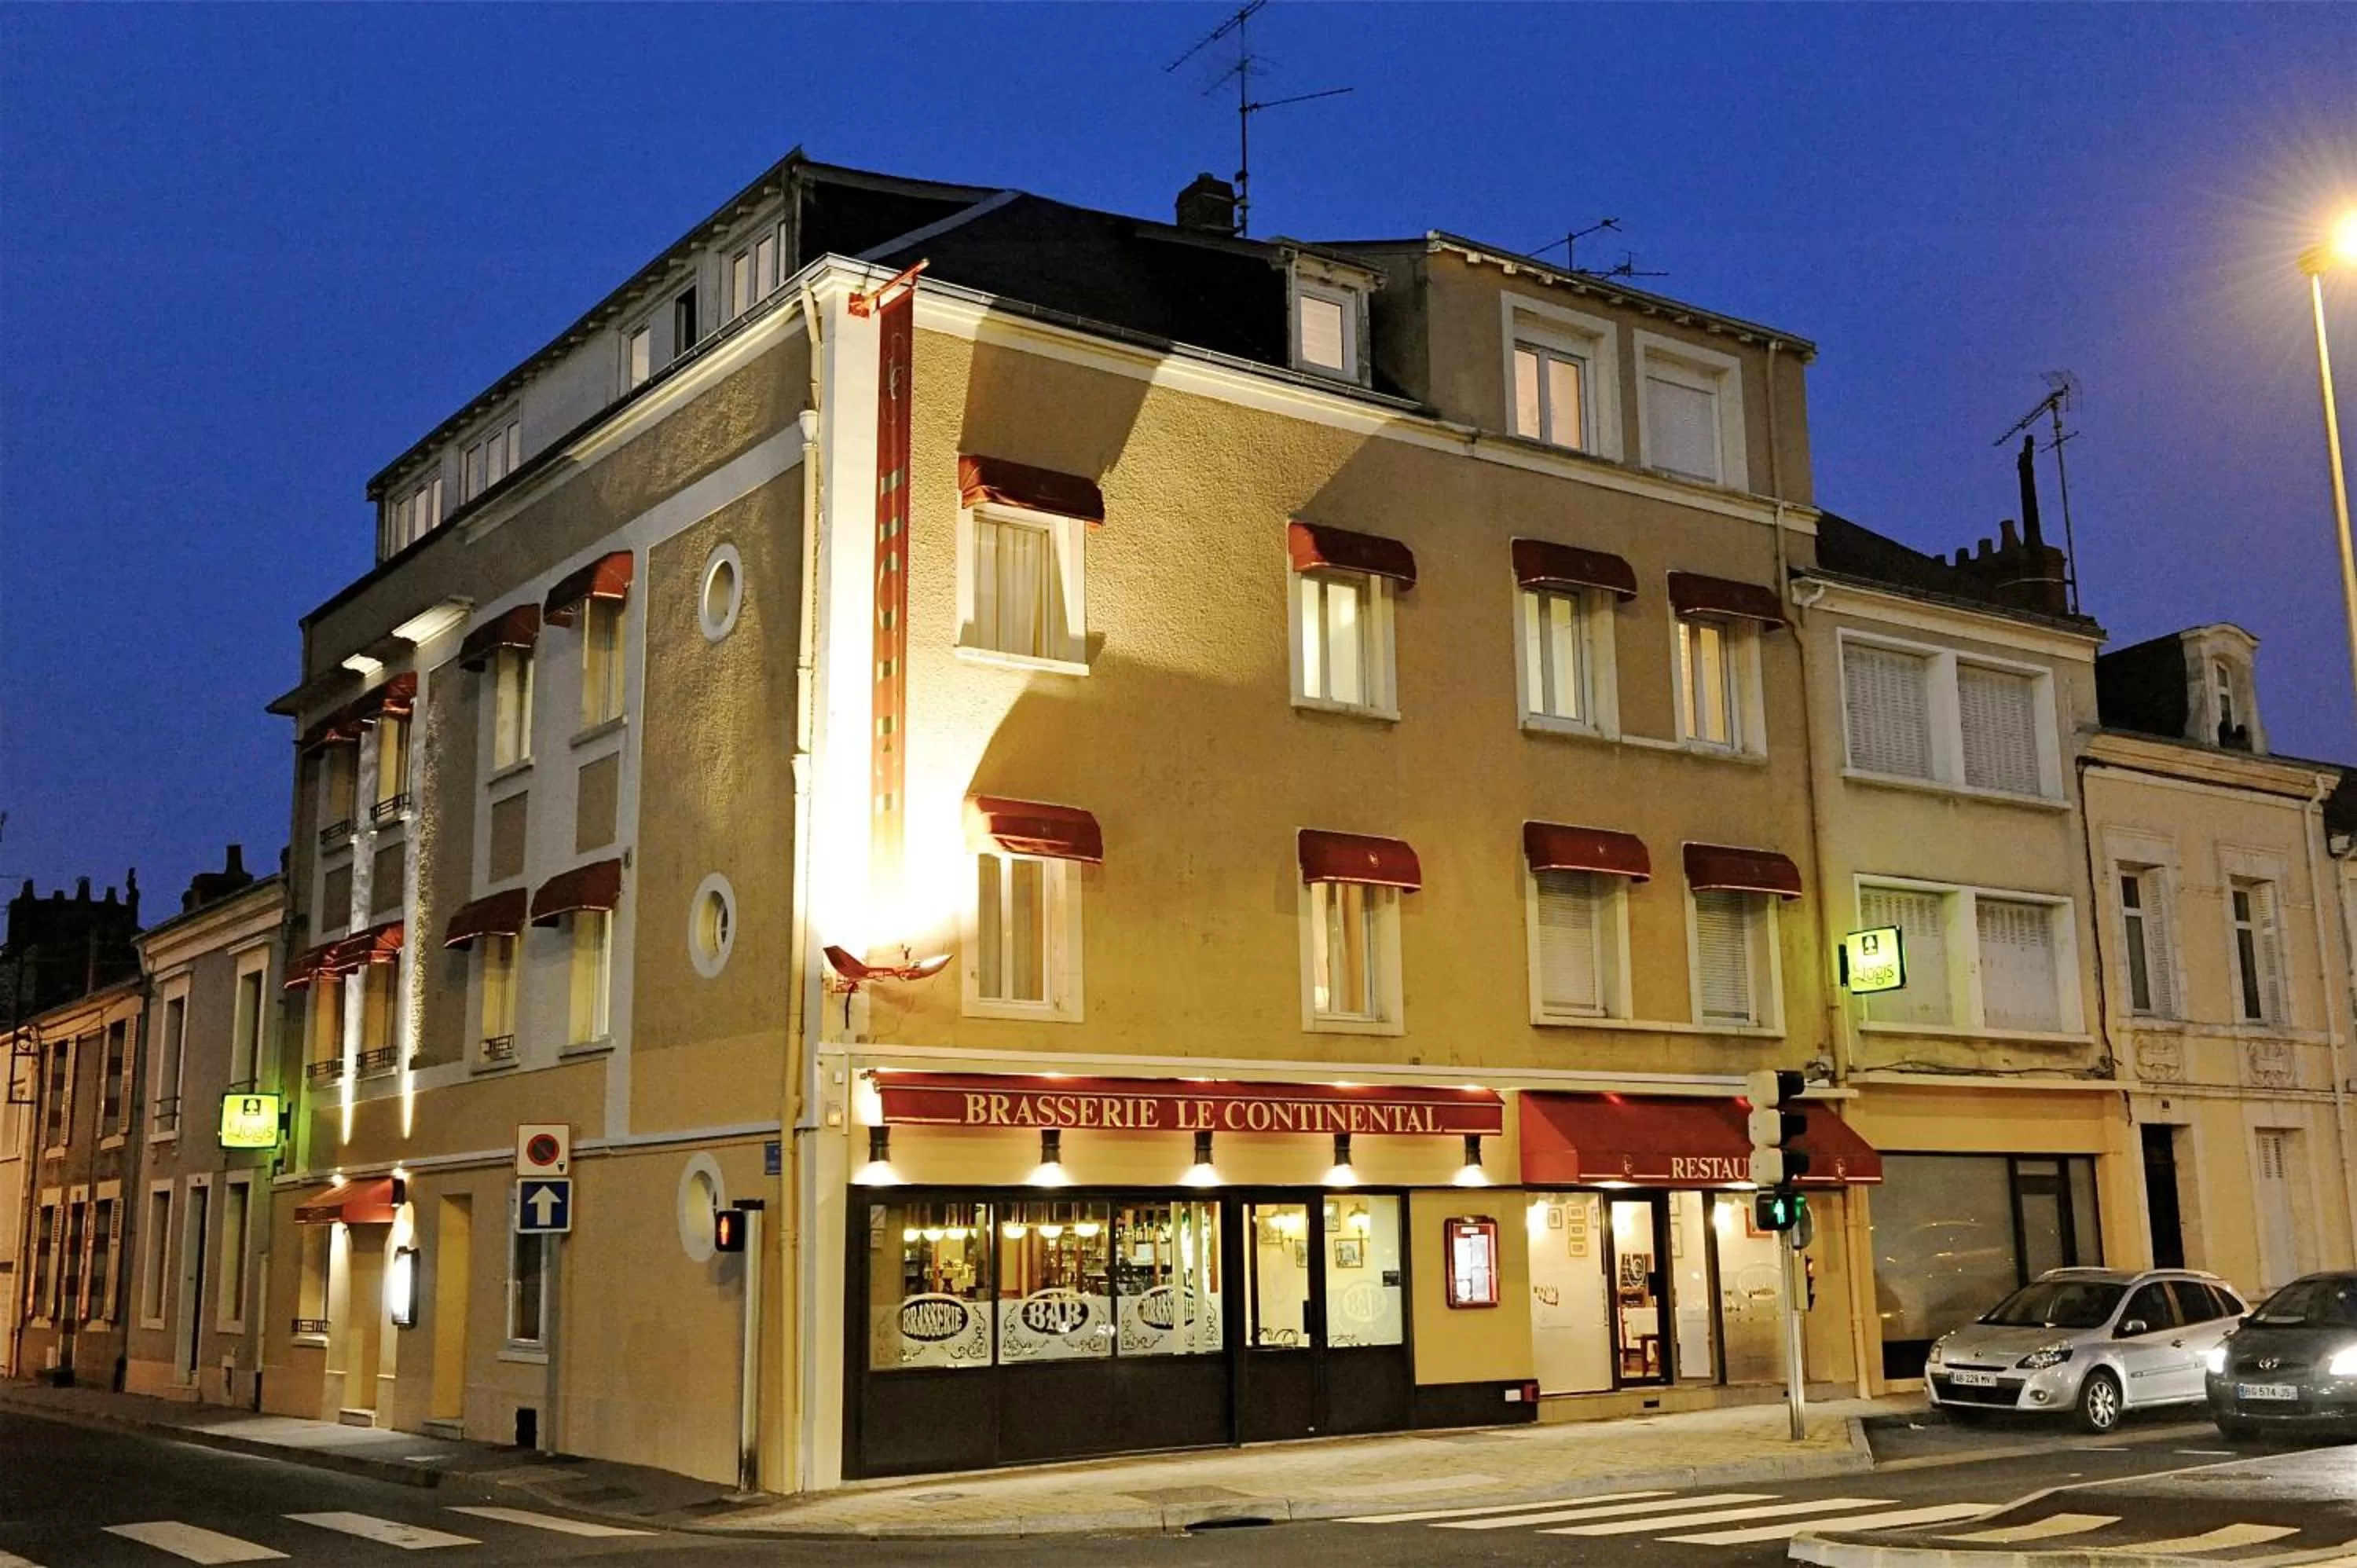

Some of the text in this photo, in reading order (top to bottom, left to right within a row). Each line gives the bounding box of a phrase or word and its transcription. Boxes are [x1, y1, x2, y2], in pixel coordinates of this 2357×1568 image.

[964, 1093, 1443, 1133] BRASSERIE LE CONTINENTAL
[1671, 1157, 1798, 1179] RESTAU
[903, 1302, 963, 1337] BRASSERIE
[1028, 1295, 1083, 1330] BAR
[1143, 1294, 1195, 1325] BRASSIE
